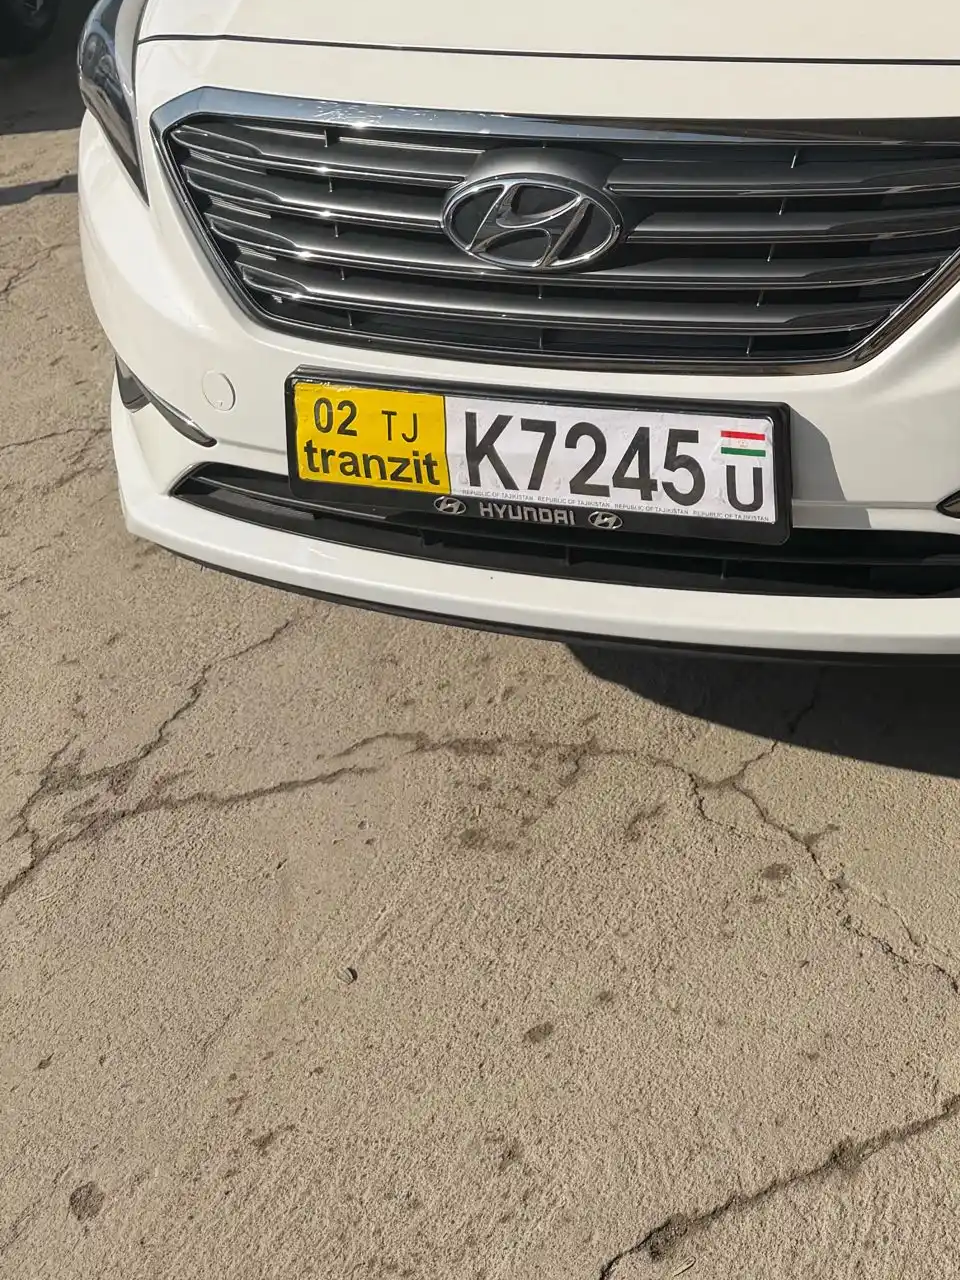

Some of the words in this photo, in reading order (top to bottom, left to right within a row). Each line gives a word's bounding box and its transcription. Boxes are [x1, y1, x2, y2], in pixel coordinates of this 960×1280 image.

[313, 397, 358, 437] 02
[381, 410, 419, 443] TJ
[303, 439, 440, 486] tranzit
[464, 411, 706, 507] K7245
[537, 495, 567, 504] REPUBLIC
[725, 464, 765, 513] U
[479, 502, 576, 526] HYUNDAI
